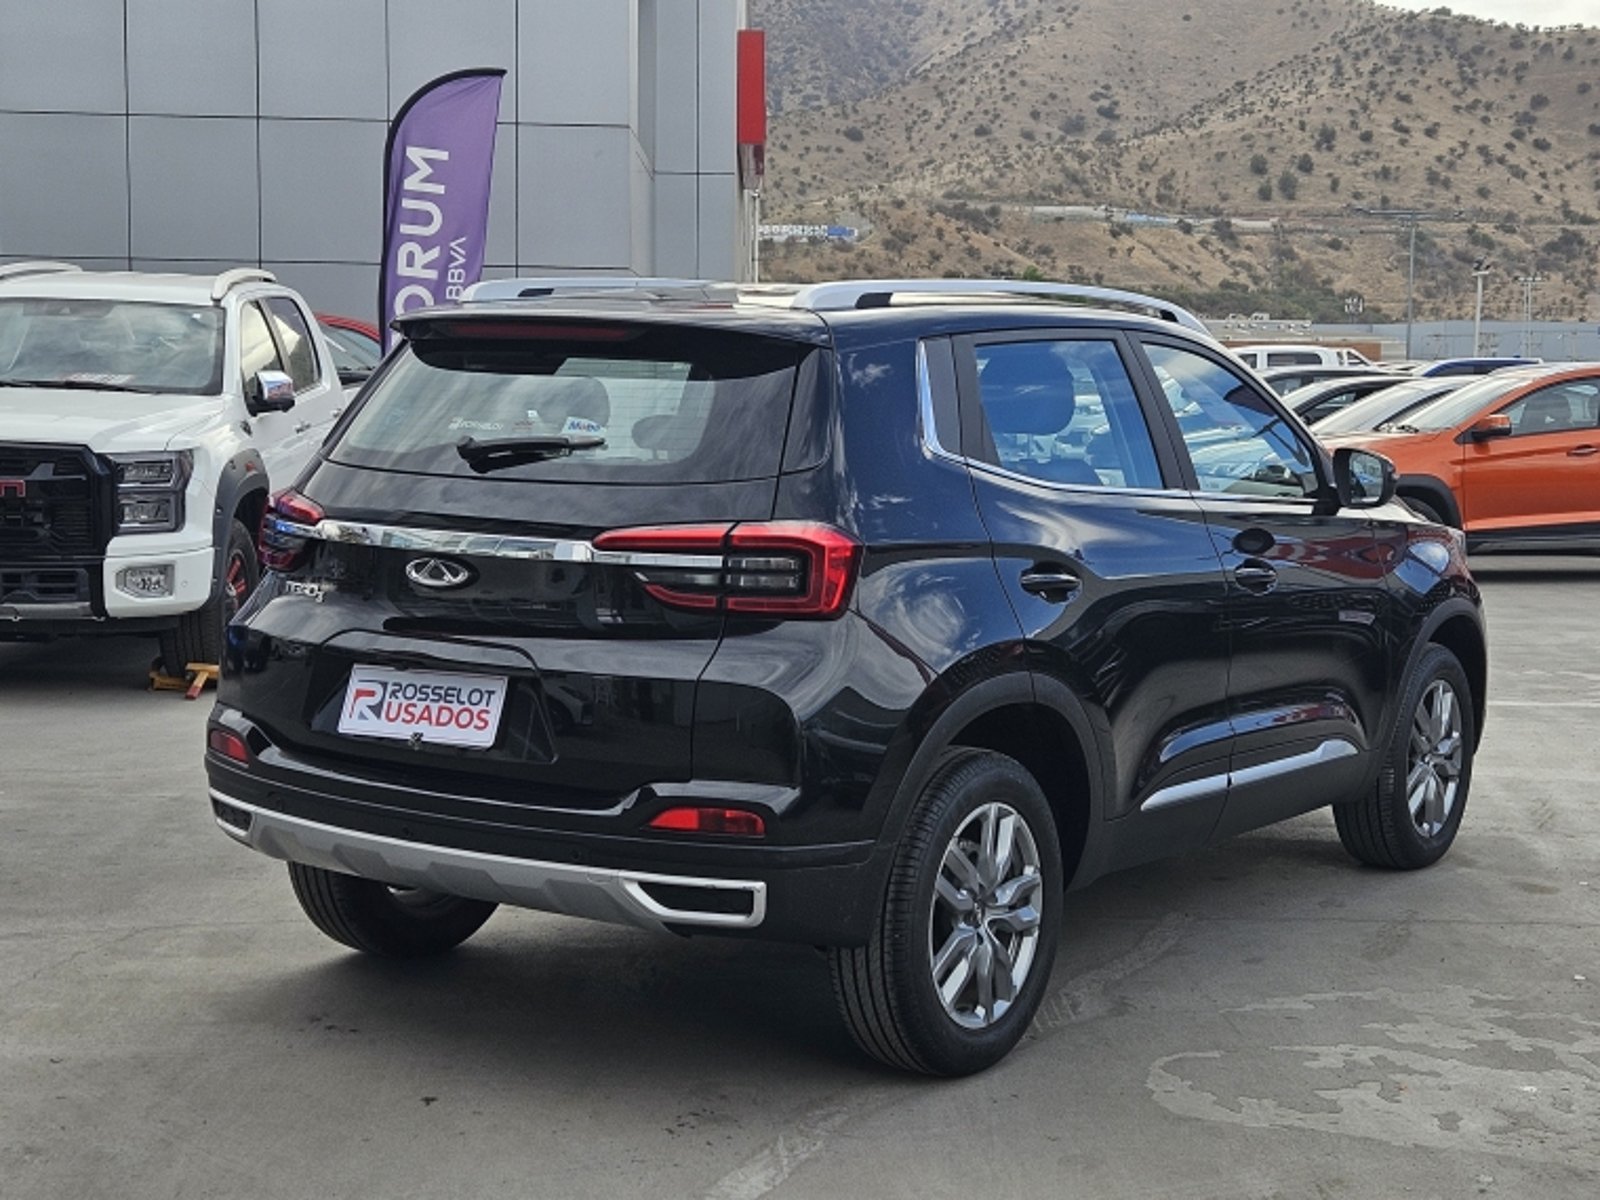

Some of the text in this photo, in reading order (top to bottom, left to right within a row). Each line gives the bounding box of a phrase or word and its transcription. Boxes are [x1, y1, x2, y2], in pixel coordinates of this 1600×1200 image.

[391, 146, 449, 346] ORUM
[446, 236, 467, 300] BBVA
[385, 701, 491, 731] USADOS
[389, 683, 496, 707] ROSSELOT
